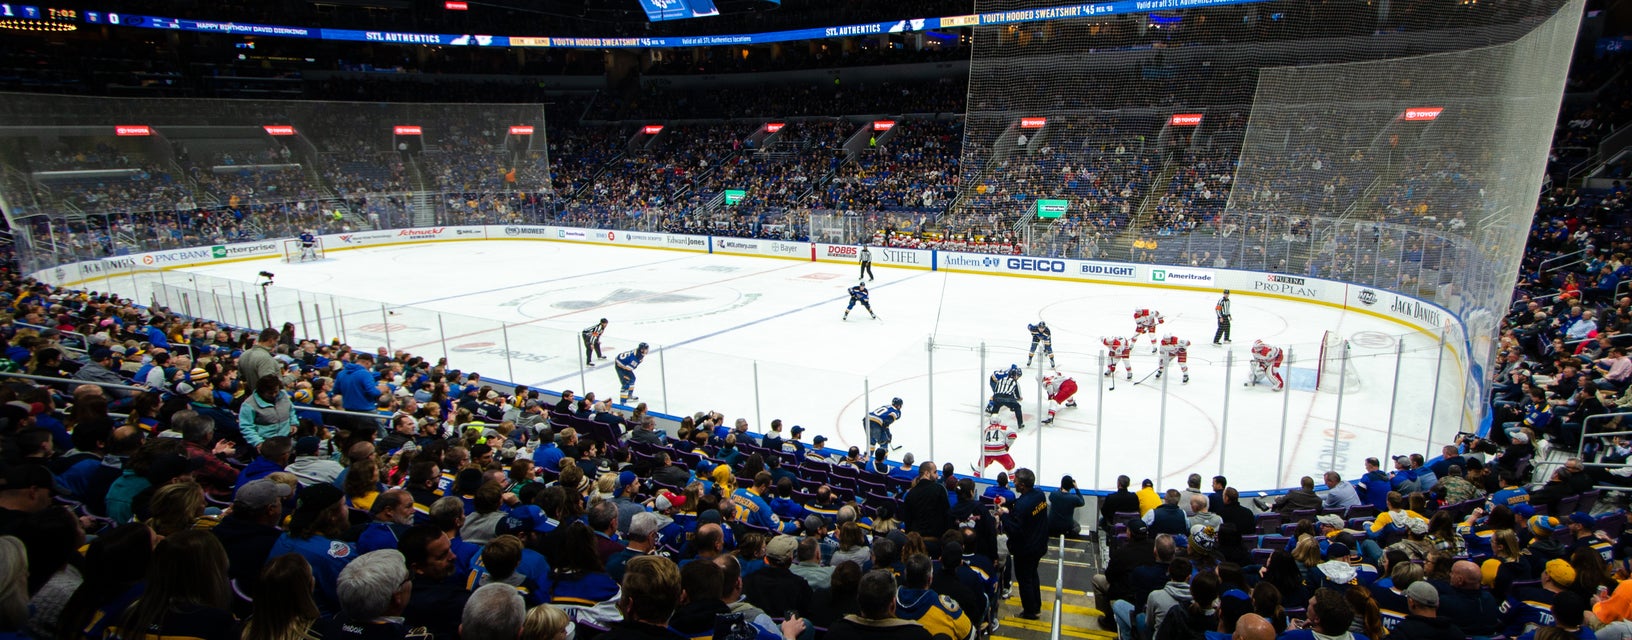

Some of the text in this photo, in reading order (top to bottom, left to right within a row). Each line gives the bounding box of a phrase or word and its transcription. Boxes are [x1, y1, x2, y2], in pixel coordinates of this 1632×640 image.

[1, 3, 14, 16] 1
[1136, 1, 1150, 9] Valid
[1159, 0, 1167, 8] all
[48, 8, 77, 19] 7:02
[108, 12, 120, 24] 0
[982, 13, 1005, 23] YOUTH
[1006, 11, 1033, 21] HOODED
[1035, 6, 1081, 19] SWEATSHIRT
[196, 22, 219, 30] HAPPY
[219, 23, 252, 32] BIRTHDAY
[826, 24, 881, 36] STL AUTHENTICS
[366, 31, 440, 43] STL AUTHENTICS
[553, 38, 575, 46] YOUTH
[575, 38, 601, 46] HOODED
[602, 38, 640, 46] SWEATSHIRT
[711, 36, 732, 44] Authentics
[398, 227, 446, 237] Schnucks
[215, 243, 276, 257] enterprise
[781, 244, 798, 253] Bayer
[828, 245, 857, 255] DOBBS
[155, 249, 210, 263] PNC BANK
[883, 249, 920, 264] STIFEL
[944, 255, 980, 267] Anthem
[1007, 258, 1065, 273] GEICO
[1082, 265, 1134, 276] BUD LIGHT
[1168, 272, 1212, 281] Ameritrade
[1274, 276, 1305, 285] PURINA
[1254, 280, 1317, 297] PRO PLAN
[1391, 296, 1440, 328] JACK DANIEL'S
[985, 429, 1000, 443] 44
